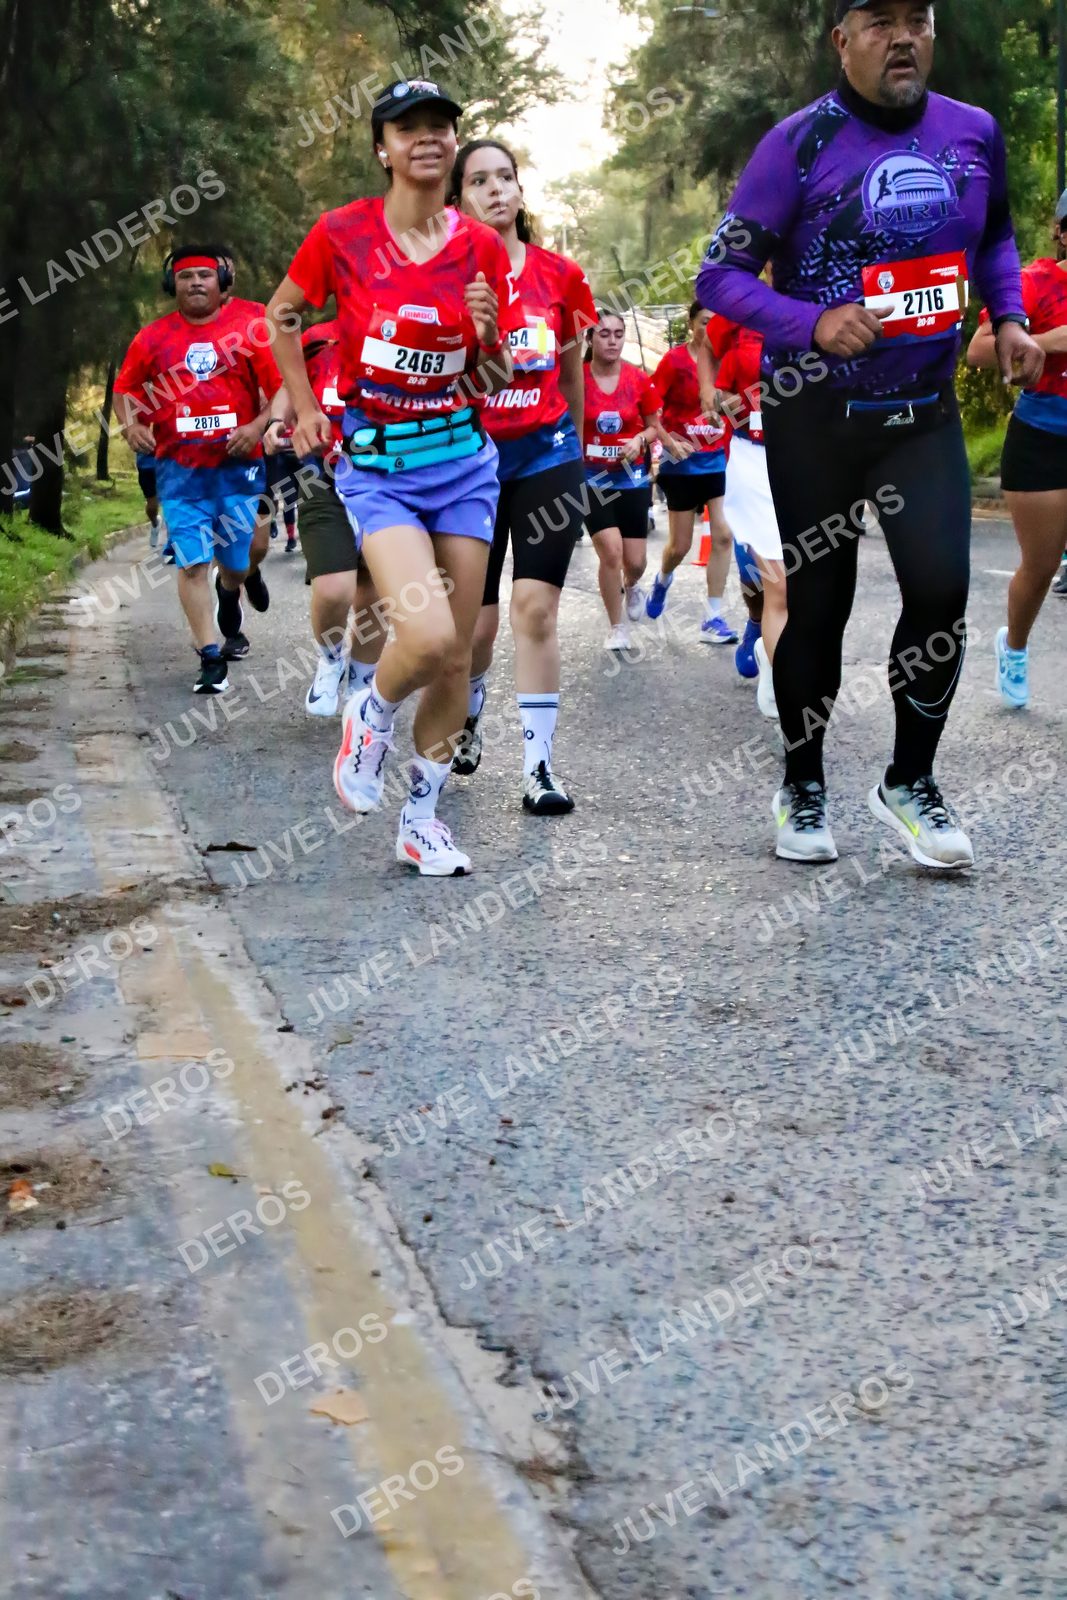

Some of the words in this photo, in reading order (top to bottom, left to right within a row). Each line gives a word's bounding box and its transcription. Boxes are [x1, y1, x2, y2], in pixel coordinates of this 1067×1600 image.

[873, 200, 954, 227] MRT
[903, 287, 944, 315] 2716
[394, 347, 446, 374] 2463
[484, 388, 541, 408] NTIAGO
[194, 416, 220, 430] 2878
